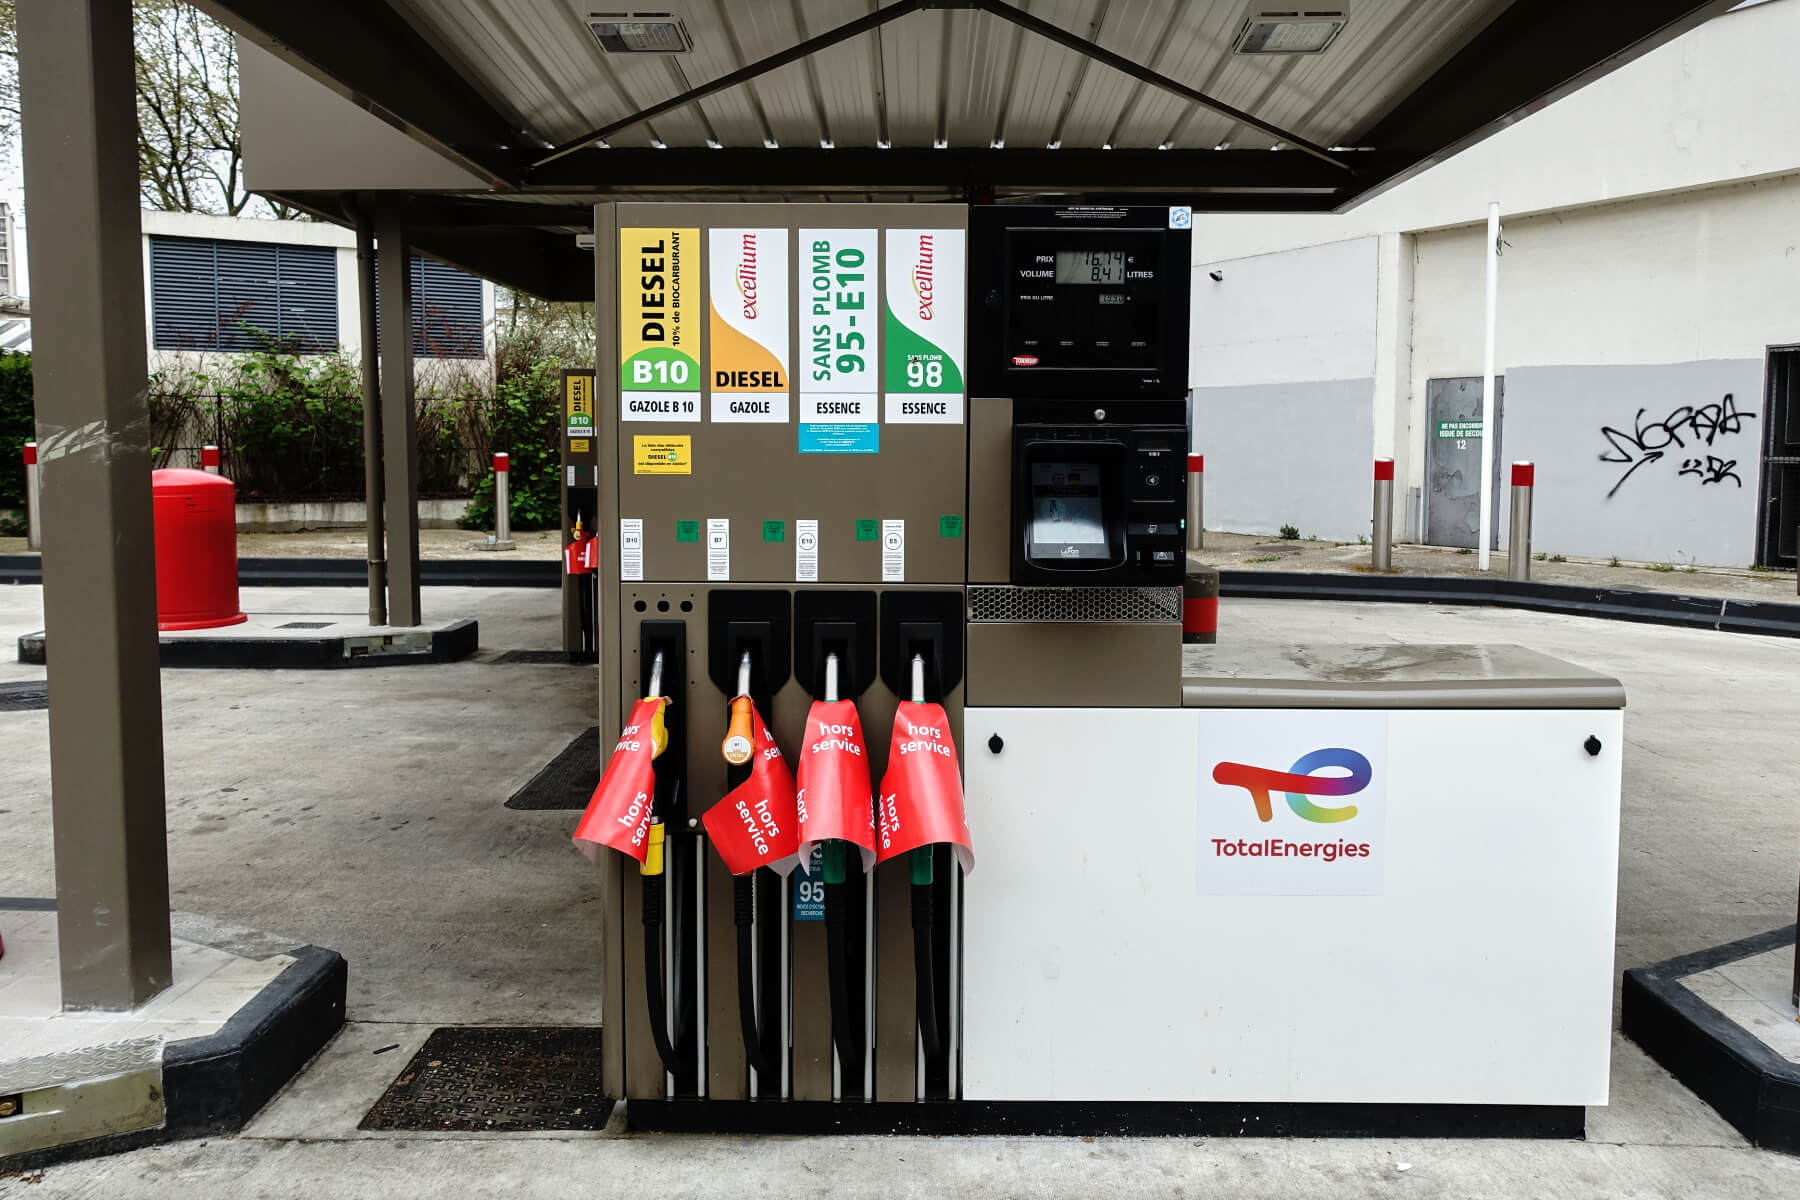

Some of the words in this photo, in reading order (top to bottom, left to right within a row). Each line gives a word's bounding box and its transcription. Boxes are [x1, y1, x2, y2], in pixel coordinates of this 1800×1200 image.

[672, 231, 680, 308] BIOCARBURANT
[1036, 255, 1054, 263] PRIX
[739, 233, 757, 320] excellium
[812, 240, 831, 316] PLOMB
[915, 234, 933, 321] excellium
[1020, 270, 1054, 278] VOLUME
[1091, 267, 1123, 282] 8.41
[1126, 271, 1154, 279] LITRES
[641, 239, 665, 342] DIESEL
[672, 310, 680, 323] de
[672, 325, 680, 347] 10%
[812, 324, 831, 381] SANS
[632, 359, 690, 385] B10
[715, 371, 784, 388] DIESEL
[906, 361, 943, 388] 98
[574, 380, 582, 412] DIESEL
[629, 400, 670, 413] GAZOLE
[672, 400, 680, 413] B
[682, 400, 695, 413] 10
[729, 401, 771, 414] GAZOLE
[816, 402, 861, 414] ESSENCE
[902, 402, 947, 415] ESSENCE
[571, 416, 588, 424] B10
[1457, 440, 1466, 449] 12
[819, 722, 853, 737] hors
[908, 721, 941, 739] hors
[812, 737, 861, 756] service
[900, 739, 951, 757] service
[617, 791, 648, 828] hors
[754, 798, 780, 838] hors
[886, 793, 900, 833] hors
[631, 805, 653, 848] servi
[735, 800, 769, 856] service
[1210, 838, 1371, 863] TotalEnergies
[800, 881, 824, 902] 95
